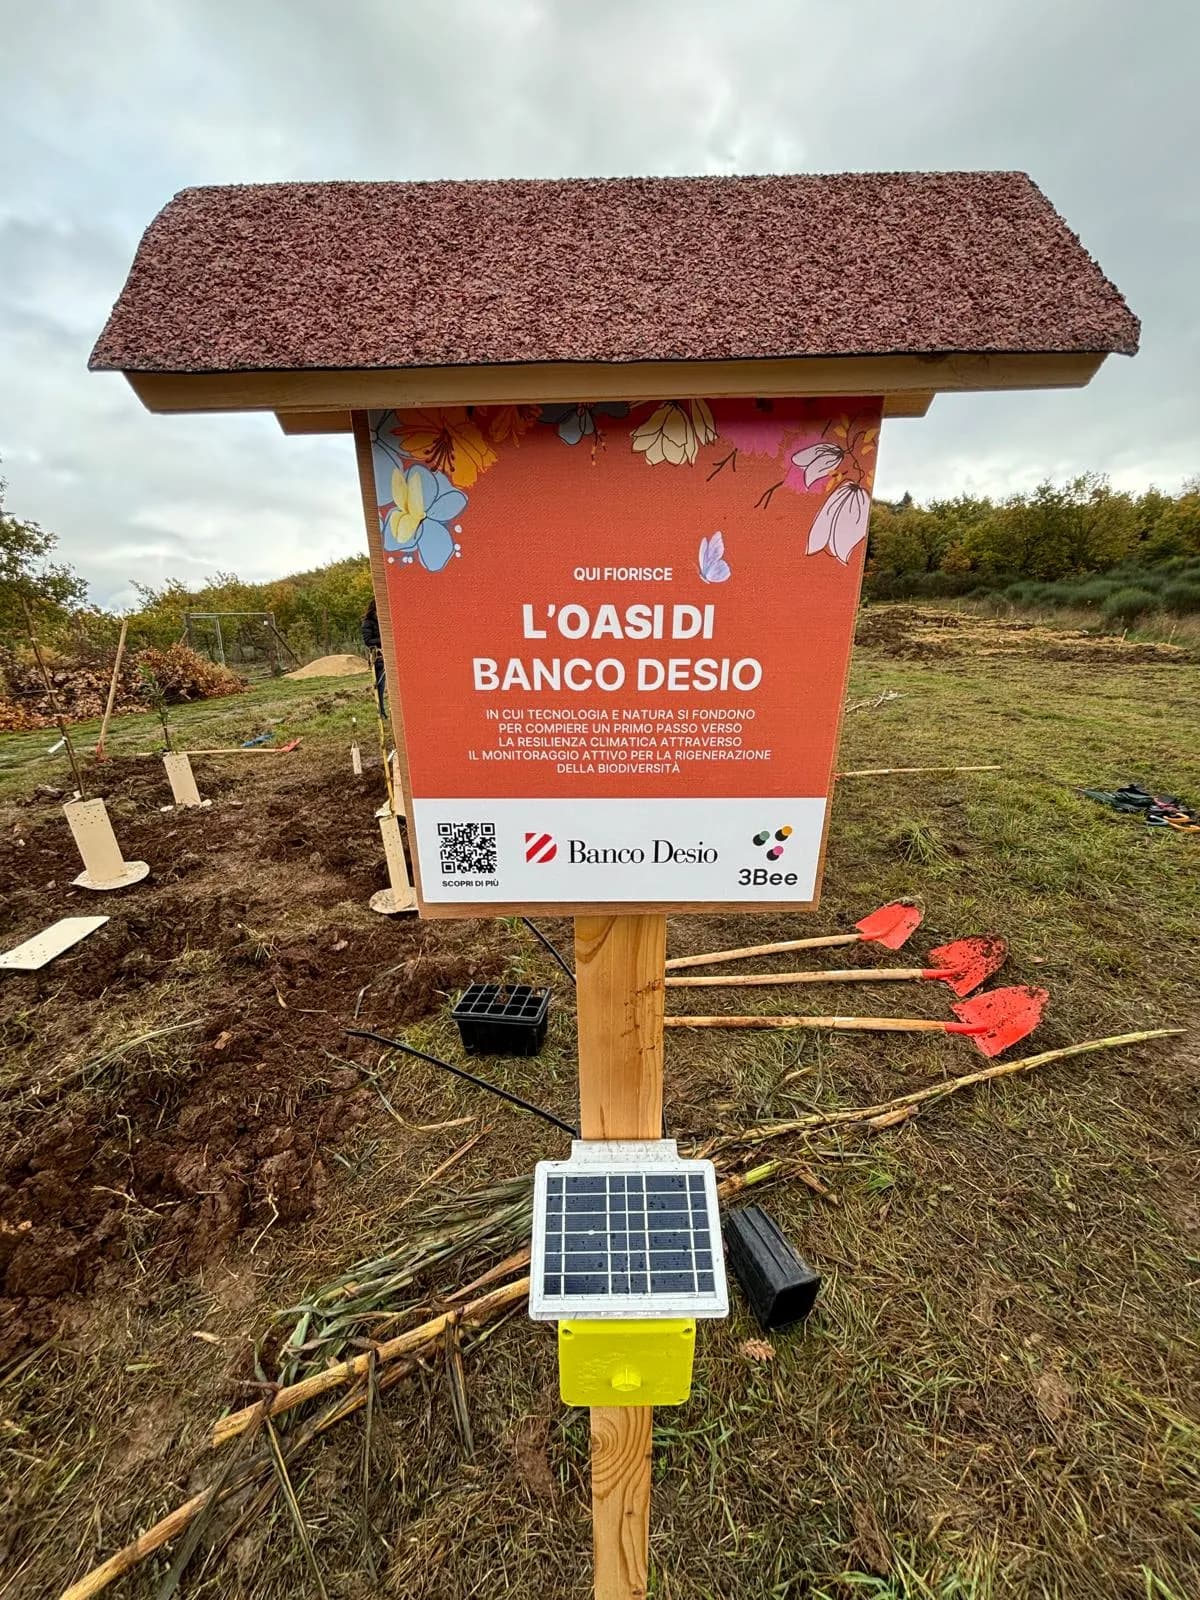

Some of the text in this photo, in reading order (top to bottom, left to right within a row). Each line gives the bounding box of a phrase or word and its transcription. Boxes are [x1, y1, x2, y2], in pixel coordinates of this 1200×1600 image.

[573, 567, 672, 582] QUI FIORISCE
[523, 604, 714, 639] L'OASI DI
[473, 658, 762, 691] BANCO DESIO
[486, 709, 756, 720] IN CUI TECNOLOGIA E NATURA SI FONDONO
[498, 722, 743, 734] PER COMPIERE UN PRIMO PASSO VERSO
[498, 736, 742, 748] LA RESILIENZA CLIMATICA ATTRAVERSO
[468, 750, 772, 761] IL MONITORAGGIO ATTIVO PER LA RIGENERAZIONE
[557, 761, 681, 774] DELLA BIODIVERSITÀ
[568, 840, 718, 864] Banco Desio
[485, 878, 500, 887] PIÙ
[738, 868, 798, 886] 3Bee
